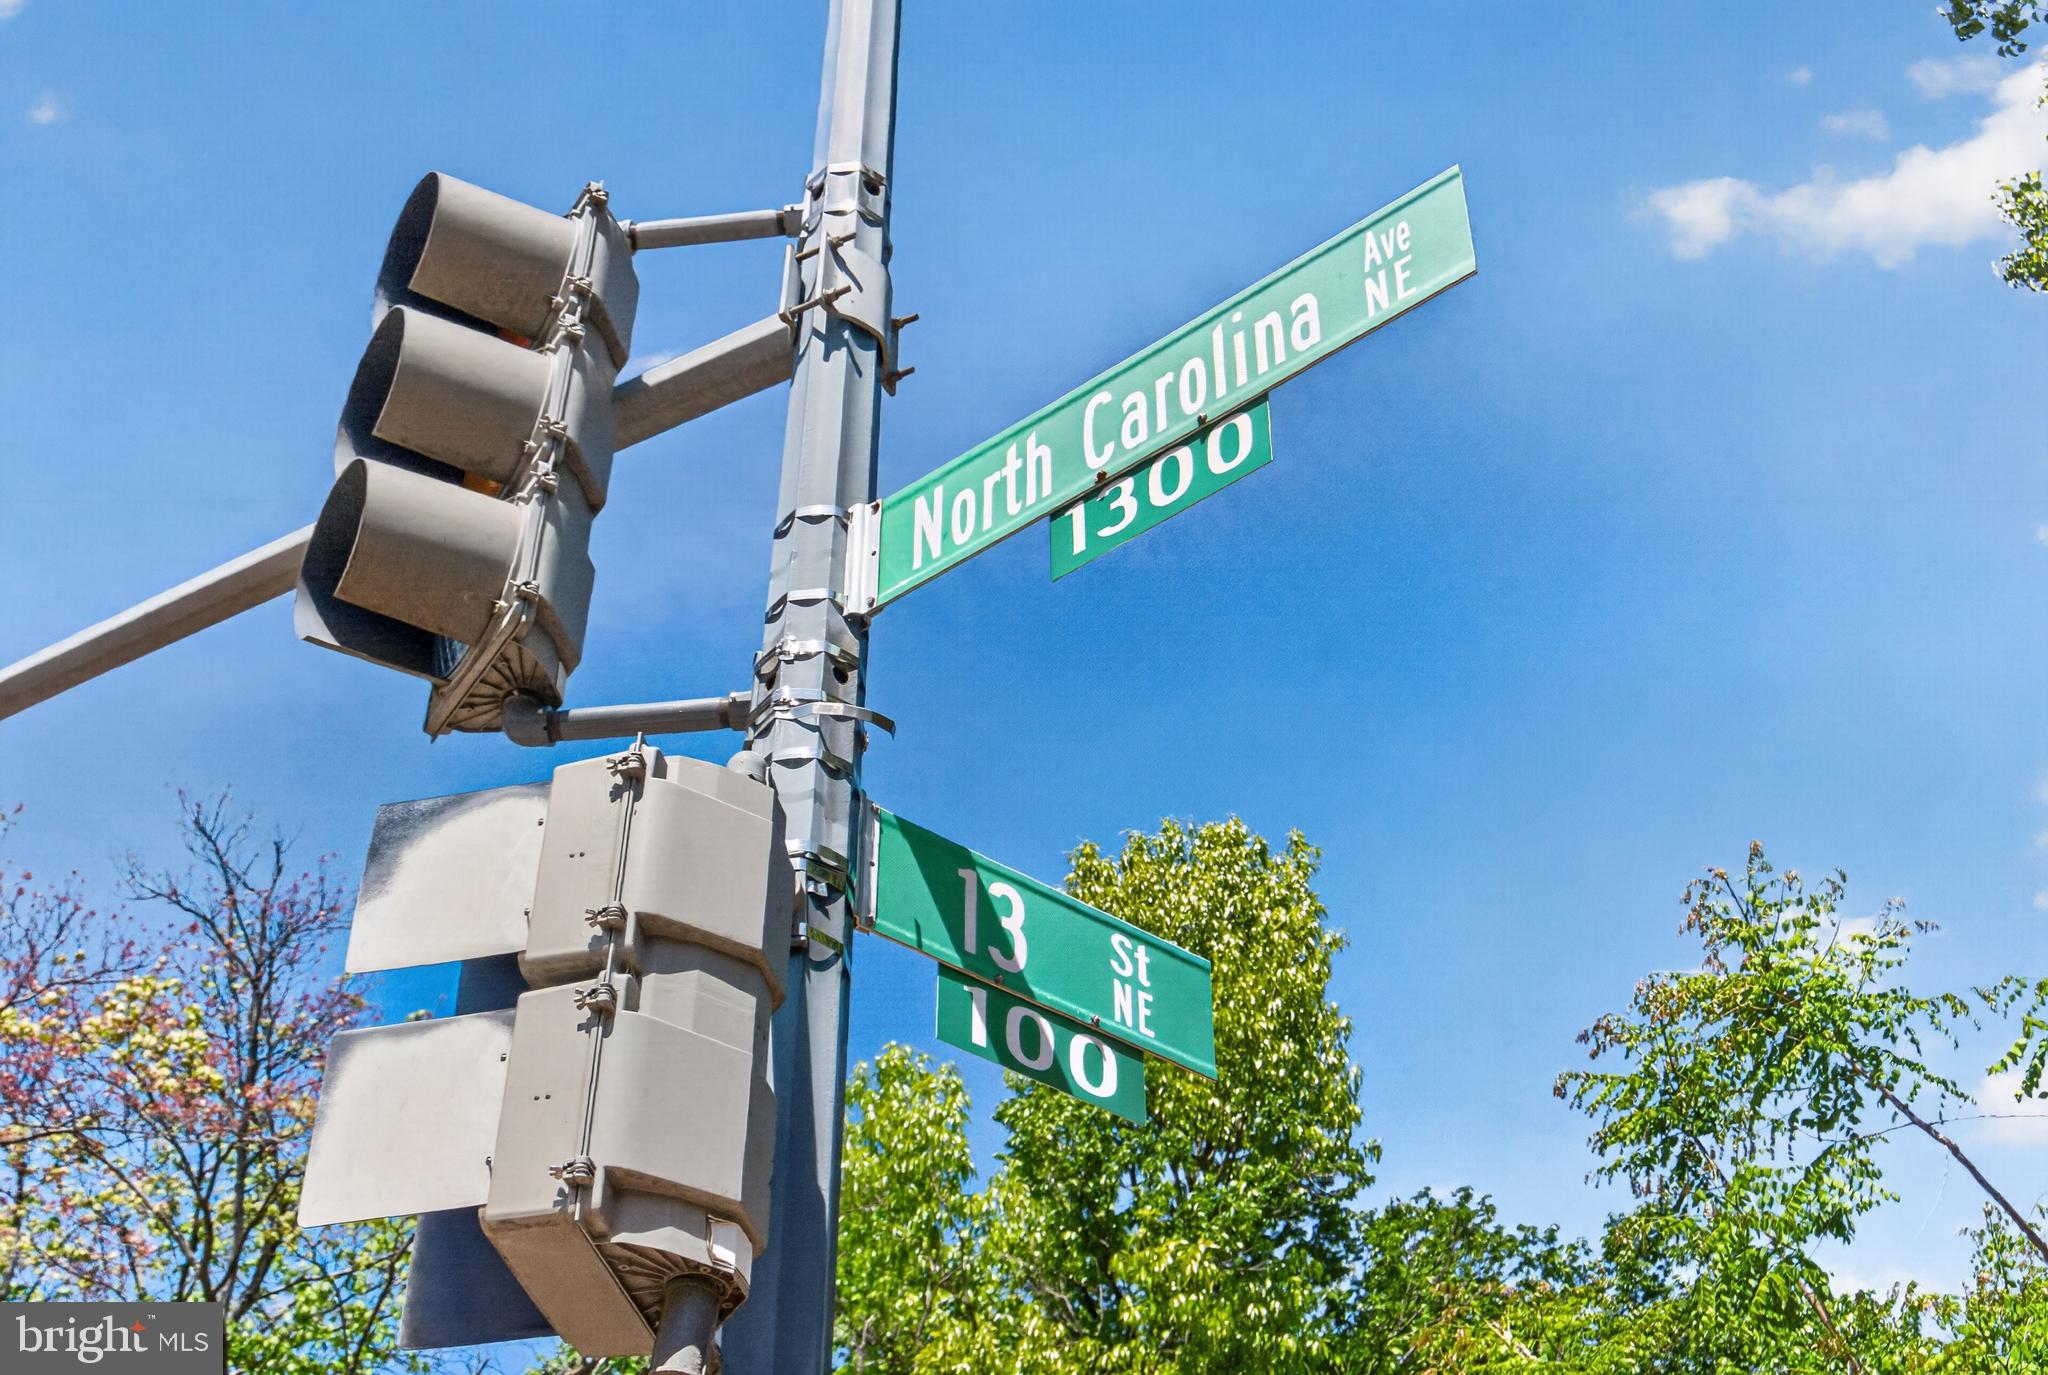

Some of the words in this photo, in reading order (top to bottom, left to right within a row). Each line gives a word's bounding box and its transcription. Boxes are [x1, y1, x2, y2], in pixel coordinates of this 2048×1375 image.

[1364, 219, 1411, 272] Ave
[1364, 255, 1417, 318] NE
[912, 431, 1053, 571] North
[1082, 292, 1322, 471] Carolina
[1064, 412, 1254, 556] 1300
[958, 867, 1028, 974] 13
[1110, 932, 1151, 988] St
[963, 984, 1119, 1098] 100
[1113, 978, 1155, 1039] NE
